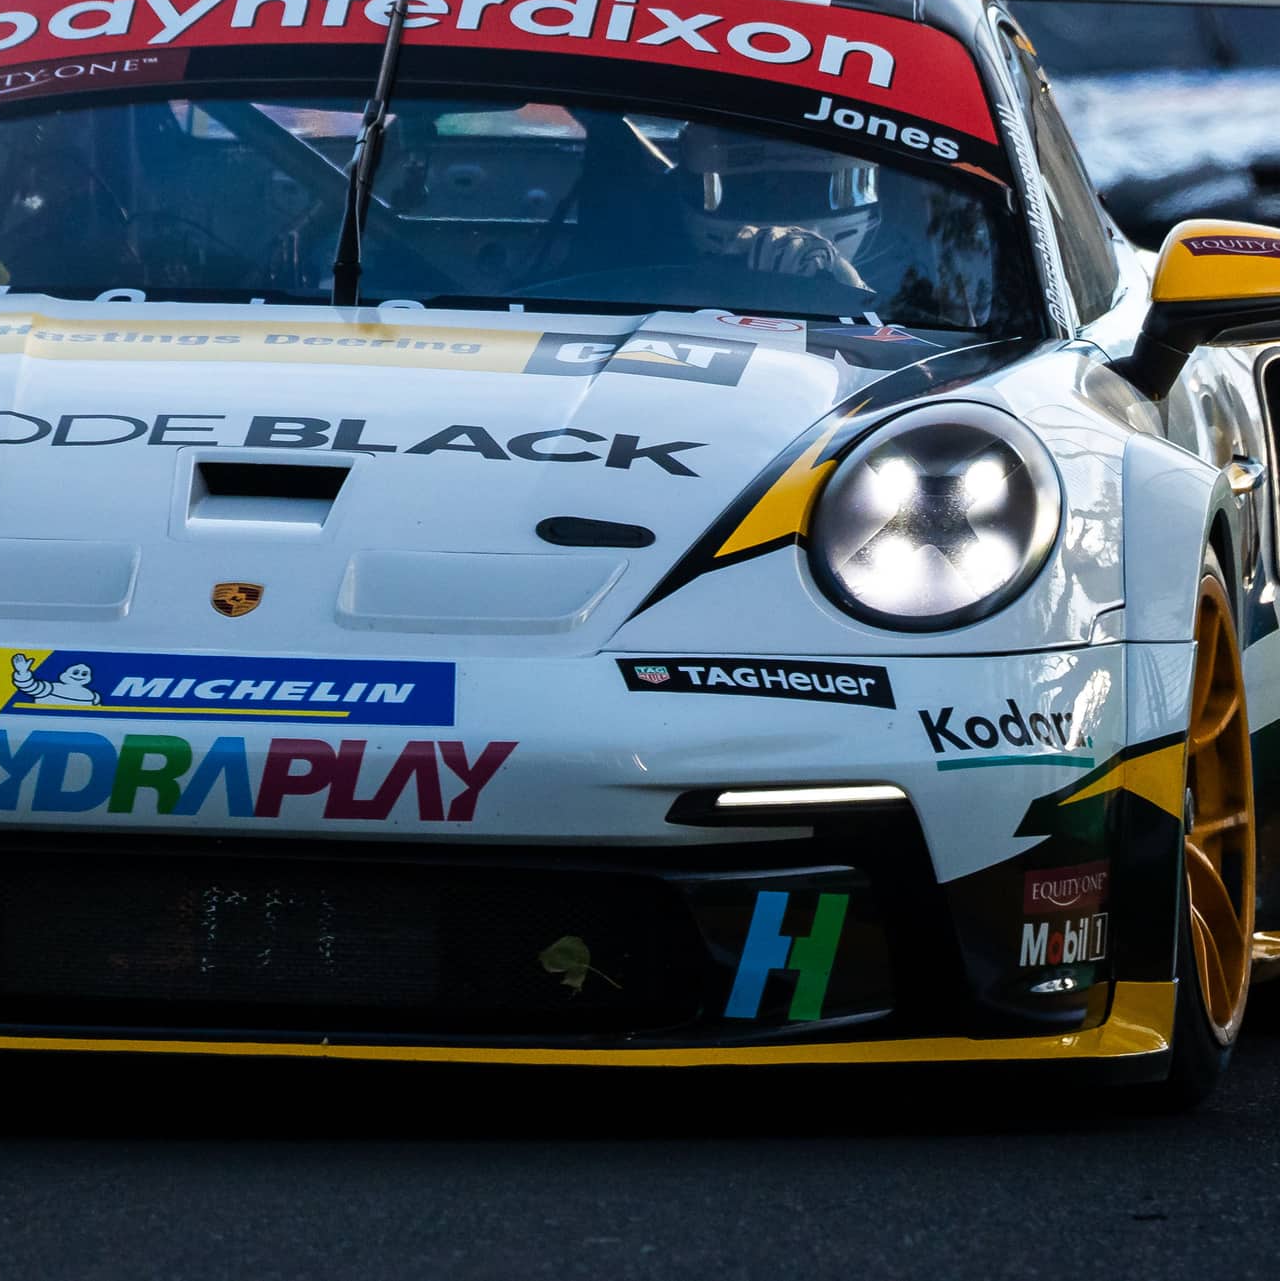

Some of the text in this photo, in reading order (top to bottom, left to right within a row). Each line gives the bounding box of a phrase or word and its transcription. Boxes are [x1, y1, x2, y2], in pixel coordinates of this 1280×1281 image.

[804, 96, 961, 161] Jones
[1190, 239, 1268, 251] EQUITY
[264, 334, 483, 354] Deering
[555, 339, 732, 369] CAT
[111, 676, 416, 704] MICHELIN
[1033, 878, 1080, 902] EQUITY
[1019, 917, 1089, 967] Mobil
